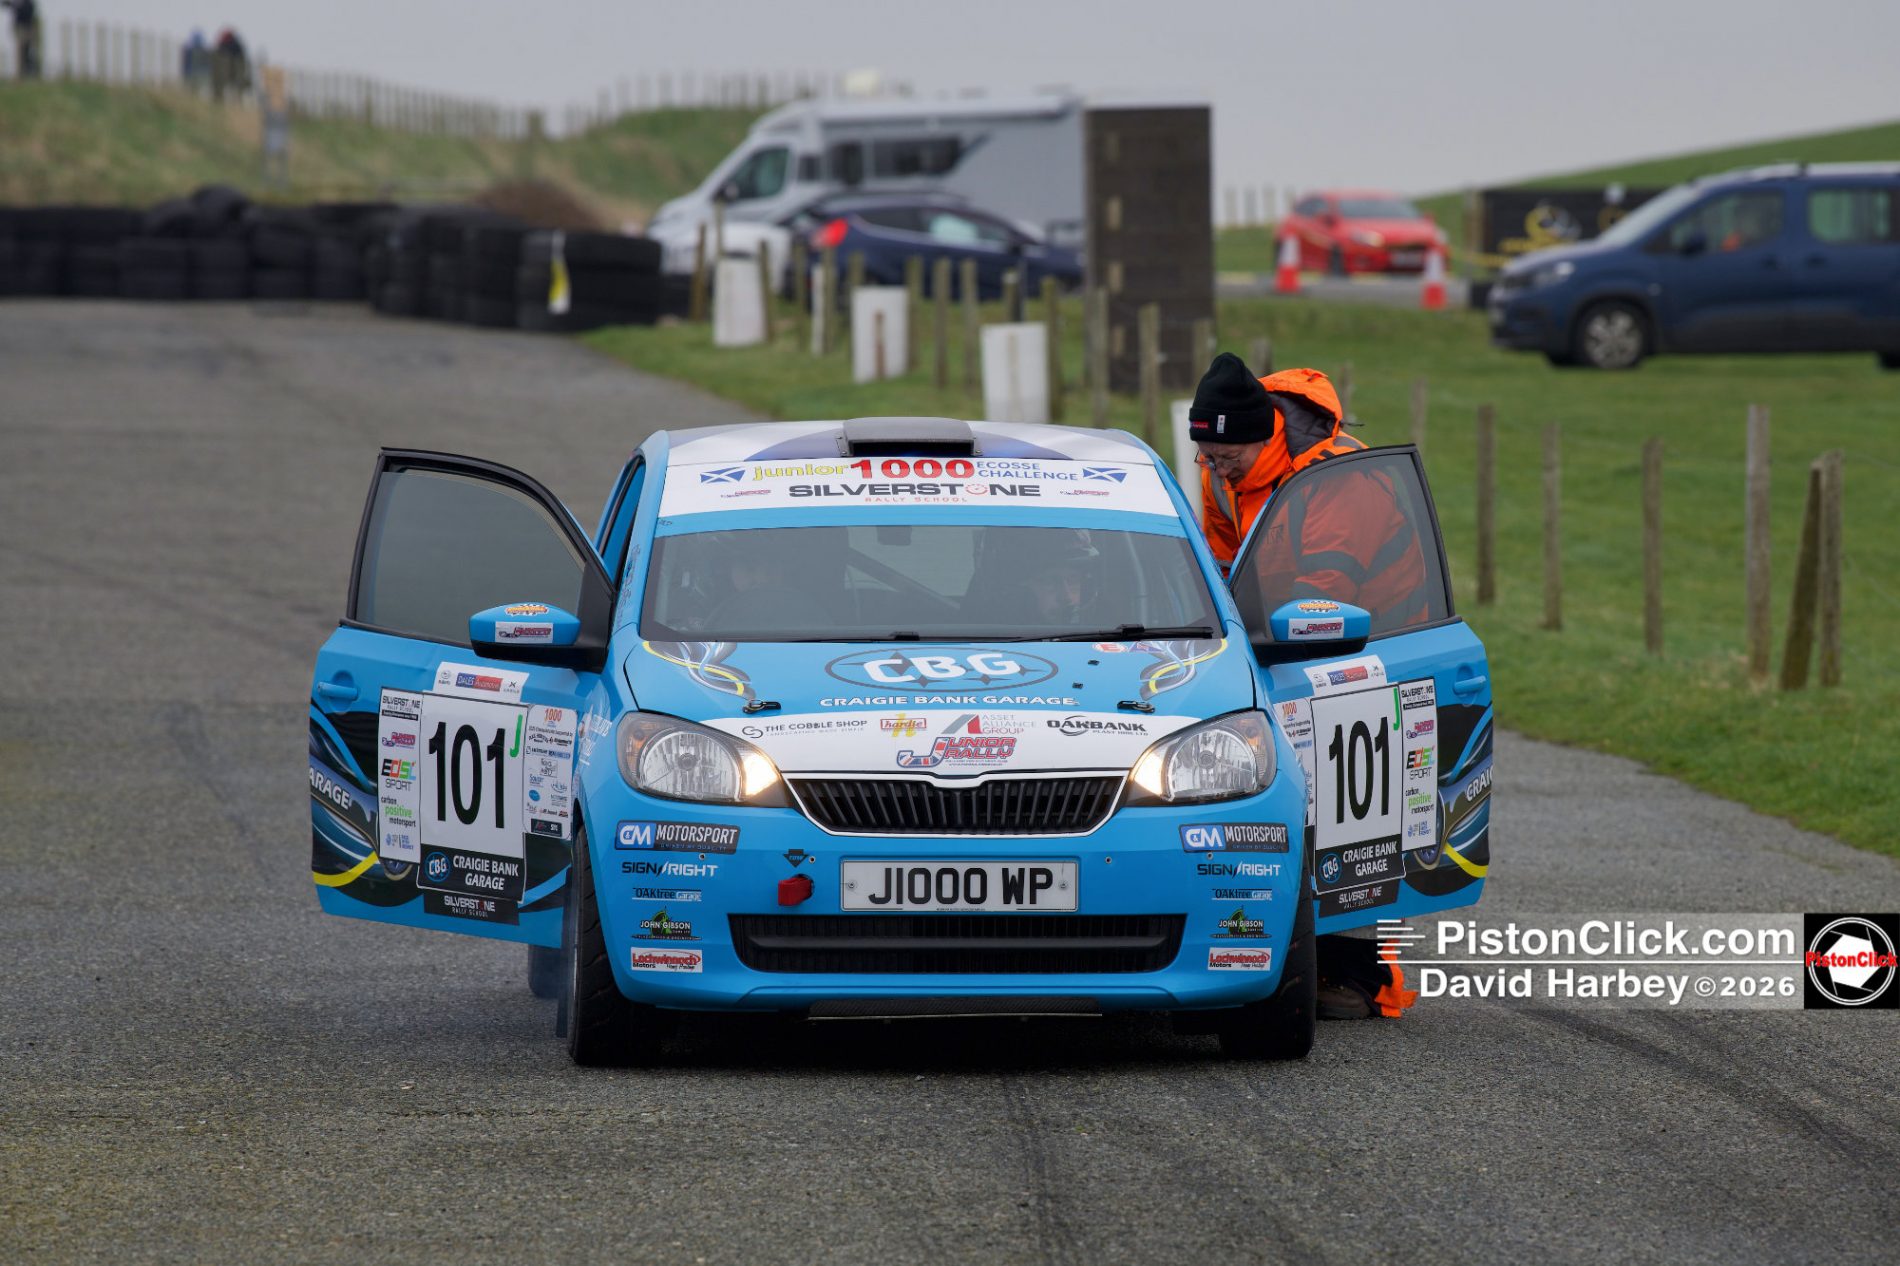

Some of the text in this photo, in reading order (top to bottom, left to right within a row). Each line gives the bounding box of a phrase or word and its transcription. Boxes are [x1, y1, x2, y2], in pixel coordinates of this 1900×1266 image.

[753, 459, 975, 481] junior 1000
[977, 461, 1040, 470] ECOSSE
[978, 469, 1079, 481] CHALLENGE
[789, 483, 1041, 498] SILVERSTONE
[863, 652, 1020, 683] CBG
[819, 695, 1075, 707] CRAIGIE BANK GARAGE
[1393, 687, 1400, 731] J
[765, 720, 868, 732] THE COBBLE SHOP
[982, 727, 1024, 735] GROUP
[1047, 719, 1147, 732] OAKBANK
[510, 714, 524, 758] J
[944, 747, 1015, 760] RALLY
[428, 721, 505, 829] 101
[1329, 716, 1389, 824] 101
[1409, 767, 1433, 781] SPORT
[385, 778, 413, 792] SPORT
[381, 796, 397, 805] carbon
[1408, 792, 1432, 809] positive
[384, 804, 413, 818] positive
[389, 817, 417, 829] motorsport
[656, 824, 737, 844] MOTORSPORT
[1224, 826, 1287, 843] MOTORSPORT
[1342, 841, 1397, 863] CRAIGIE BANK
[428, 857, 448, 876] CBG
[453, 854, 519, 877] CRAIGIE BANK
[622, 862, 720, 877] SIGN RIGHT
[1197, 864, 1281, 876] SIGN RIGHT
[1322, 857, 1339, 879] CBG
[1355, 858, 1388, 877] GARAGE
[465, 872, 505, 891] GARAGE
[1002, 867, 1053, 904] WP
[640, 920, 691, 929] JOHN GIBSON
[1218, 920, 1263, 928] JOHN GIBSON
